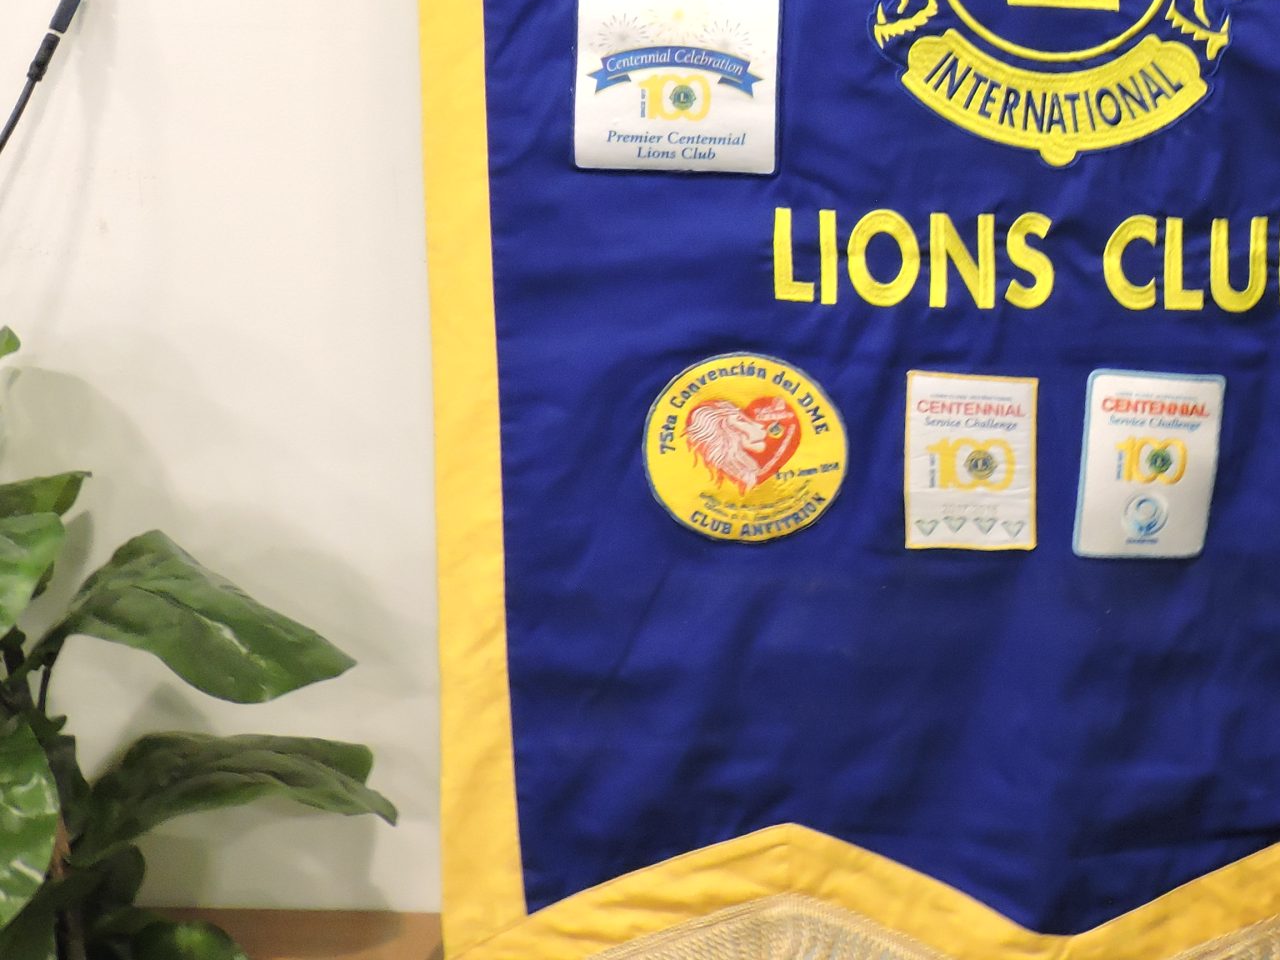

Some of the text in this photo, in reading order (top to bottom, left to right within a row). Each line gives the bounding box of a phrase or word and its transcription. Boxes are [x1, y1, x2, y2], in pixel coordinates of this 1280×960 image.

[606, 48, 744, 76] Centennial Celebration
[638, 73, 712, 122] 100
[925, 50, 1184, 135] INTERNATIONAL
[606, 130, 746, 146] Premier Centennial
[637, 147, 716, 161] Lions Club
[773, 207, 1055, 309] LIONS
[670, 361, 768, 409] Convención
[772, 370, 801, 396] del
[798, 392, 831, 435] DME
[916, 399, 1027, 418] CENTENNIAL
[1101, 397, 1210, 418] CENTENNIAL
[923, 415, 1019, 432] Service Challenge
[1107, 415, 1146, 427] Service
[926, 437, 1017, 492] 100
[1114, 436, 1189, 486] 100
[690, 510, 734, 535] CLUB
